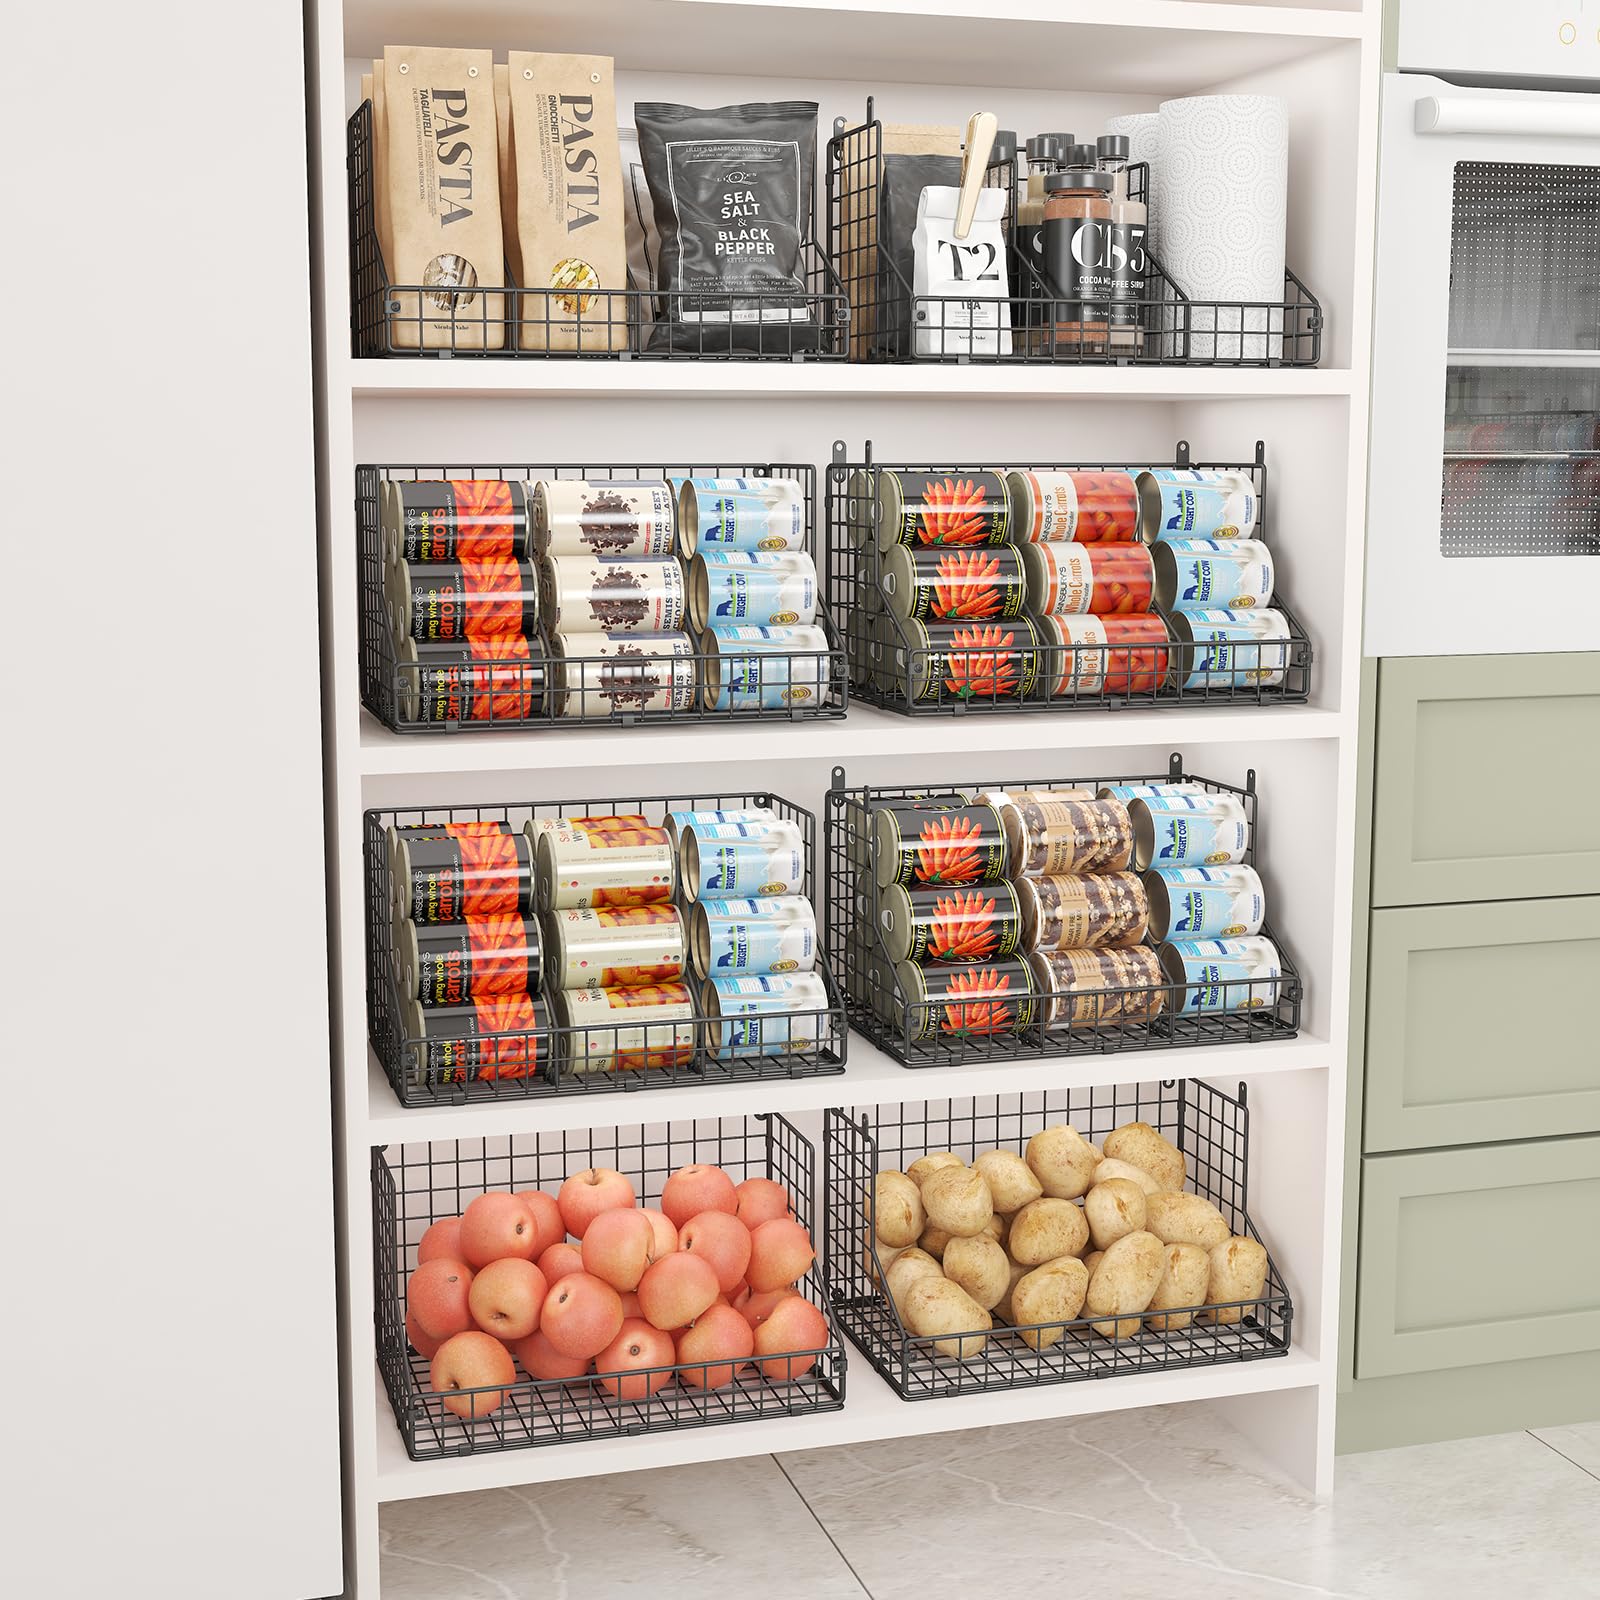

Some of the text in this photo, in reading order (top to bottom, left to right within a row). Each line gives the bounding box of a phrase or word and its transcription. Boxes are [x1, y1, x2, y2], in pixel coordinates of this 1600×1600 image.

[419, 88, 433, 138] TAGLIATELLI
[547, 94, 560, 143] GNOCCHETTI
[431, 87, 473, 229] PASTA
[558, 92, 600, 235] PASTA
[720, 203, 760, 219] SALT
[722, 190, 756, 205] SEA
[718, 228, 770, 242] BLACK
[737, 217, 747, 227] &
[715, 241, 775, 256] PEPPER
[937, 239, 1000, 281] T2
[1079, 275, 1102, 284] COCOA
[724, 498, 735, 543] BRIGHT COW
[1048, 486, 1068, 542] Whole Carrots
[1183, 489, 1195, 531] BRIGHT COW
[419, 511, 429, 541] whole
[1068, 558, 1083, 588] Carrots
[1199, 559, 1211, 602] BRIGHT COW
[427, 589, 437, 619] whole
[735, 573, 746, 618] BRIGHT COW
[1063, 589, 1082, 614] Whole
[1083, 631, 1098, 662] Caots
[435, 700, 446, 720] young
[1176, 818, 1187, 859] BRIGHT COW
[725, 847, 736, 890] BRIGHT COW
[1051, 853, 1060, 871] SUGAR
[1057, 847, 1067, 872] BROWNIE
[427, 873, 437, 902] whole
[437, 869, 454, 921] carrots
[1192, 891, 1203, 932] BRIGHT COW
[736, 925, 747, 968] BRIGHT COW
[1065, 928, 1074, 946] SUGAR
[1071, 922, 1082, 946] BROWNIE
[434, 954, 445, 982] whole
[444, 949, 462, 1003] carrots
[1208, 965, 1219, 1006] BRIGH COW
